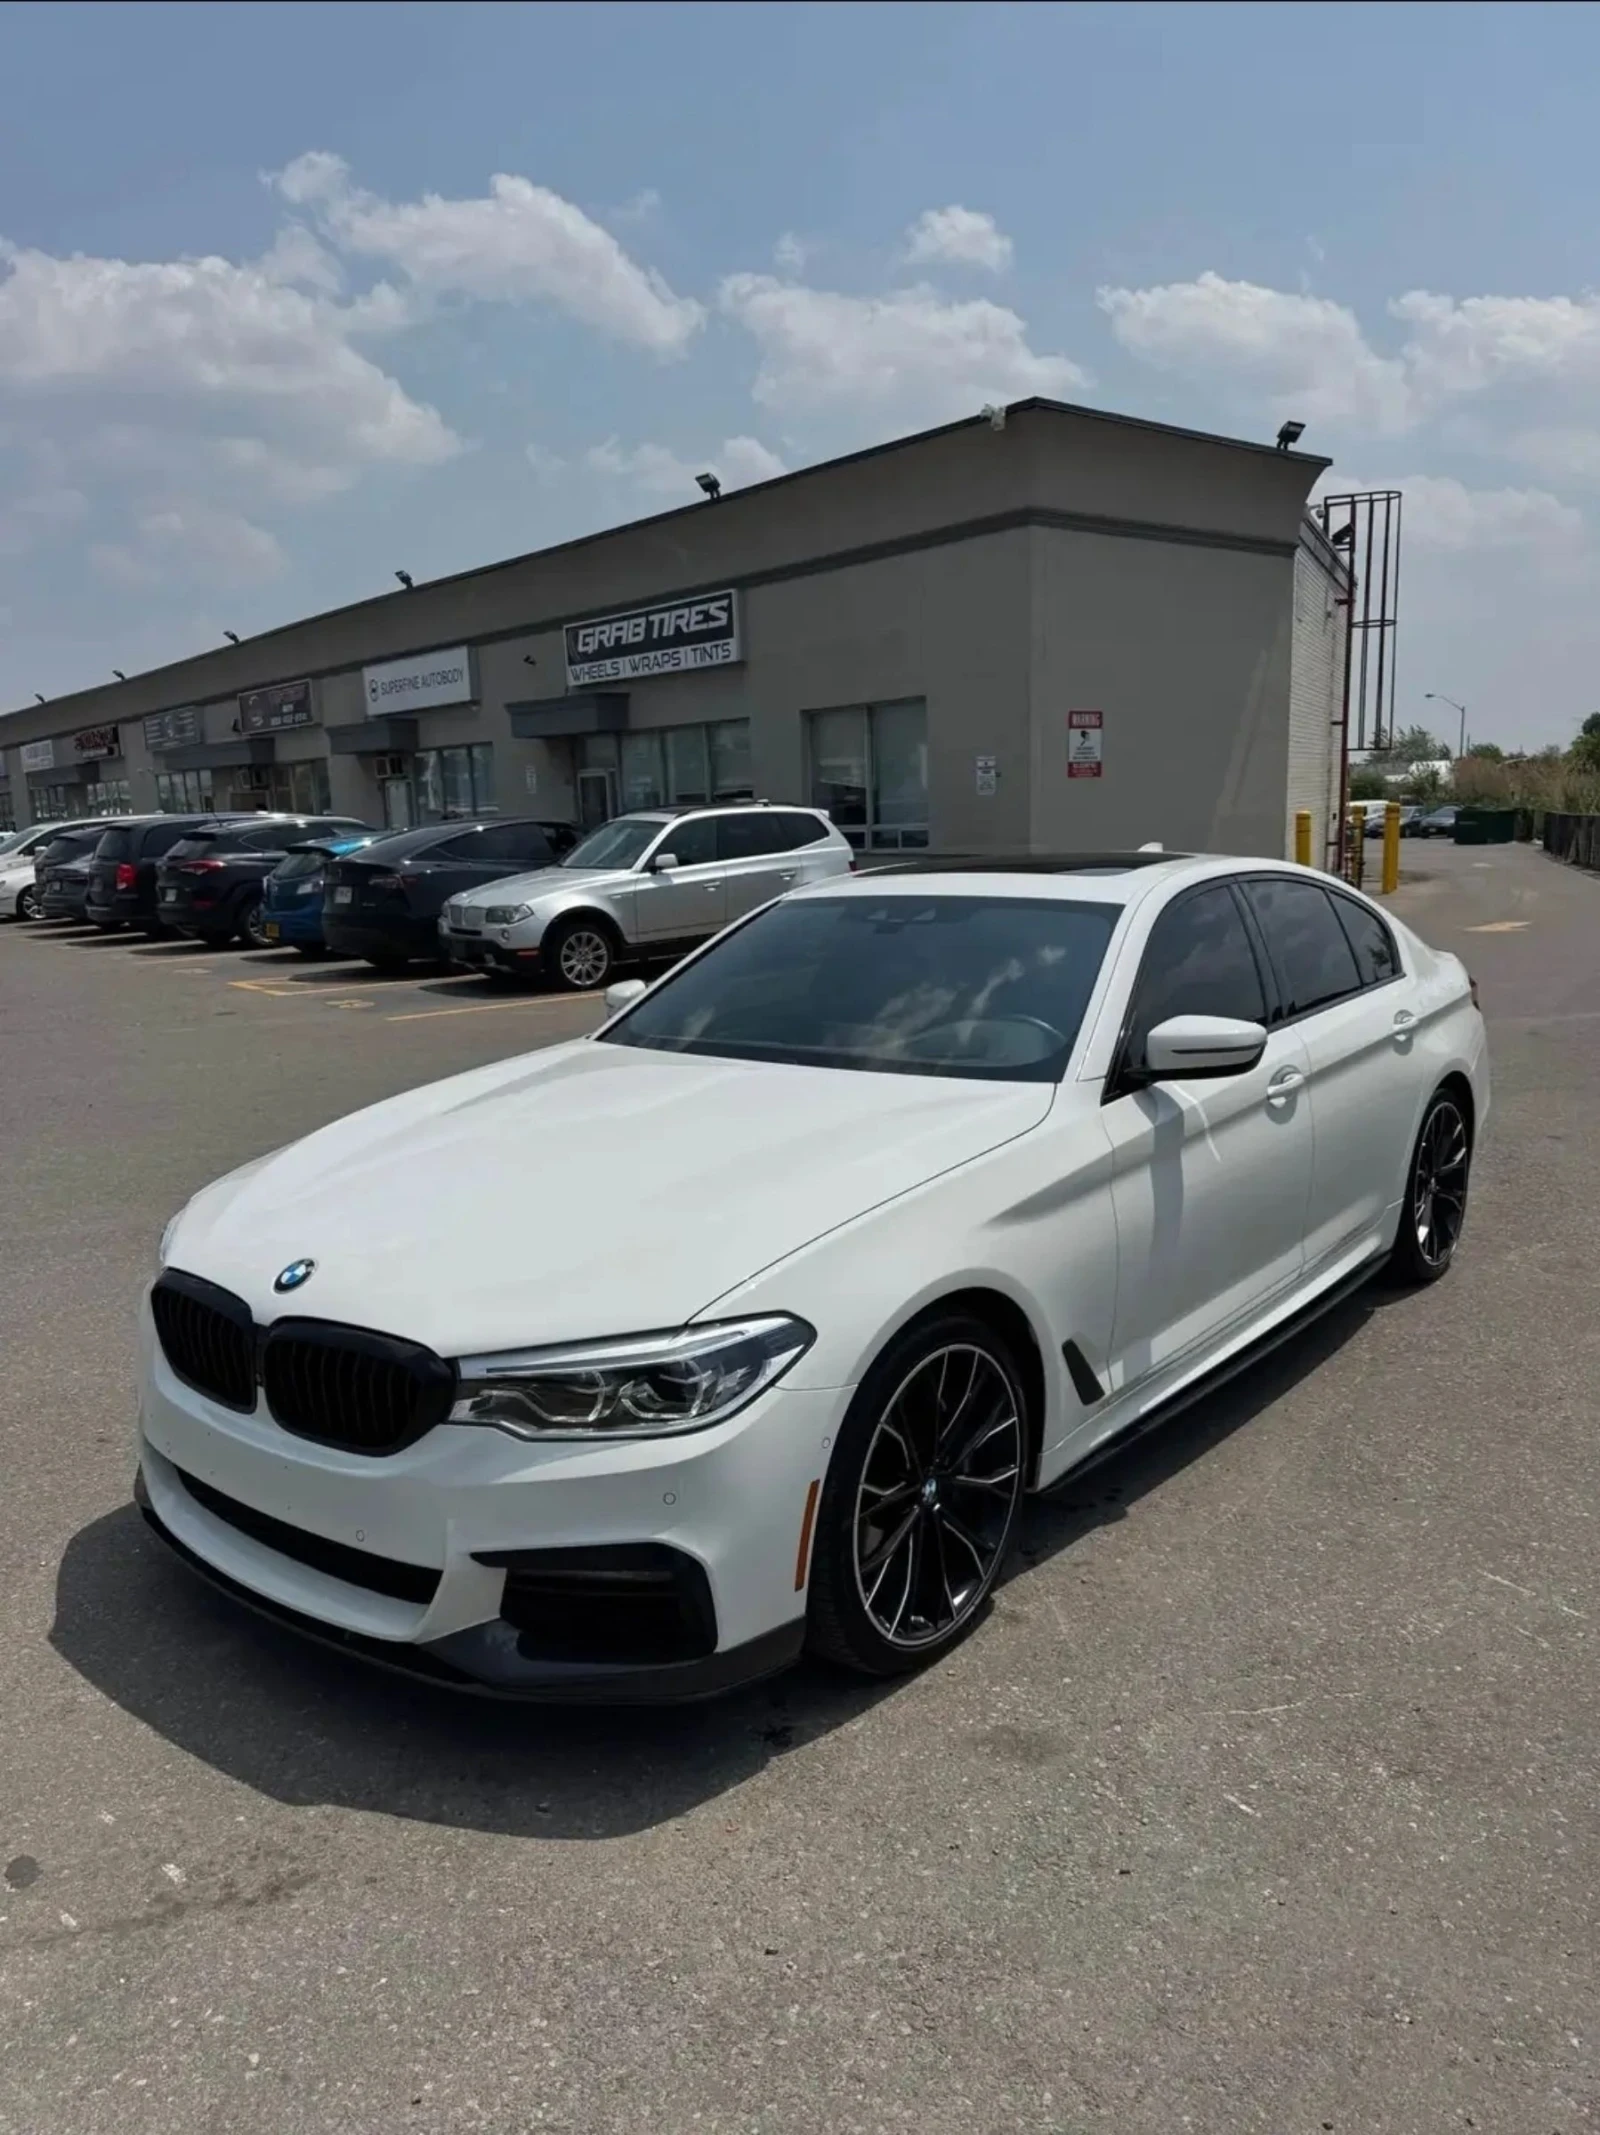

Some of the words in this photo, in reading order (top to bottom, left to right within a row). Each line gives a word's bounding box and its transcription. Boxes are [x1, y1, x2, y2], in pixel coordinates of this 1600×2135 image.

[577, 616, 647, 655] GRAB
[647, 598, 730, 639] TIRES
[380, 675, 420, 696] SUPERFINE
[421, 667, 465, 689] AUTOBODY
[571, 660, 621, 682] WHEELS
[628, 651, 682, 673] WRAPS
[691, 642, 731, 664] TINTS
